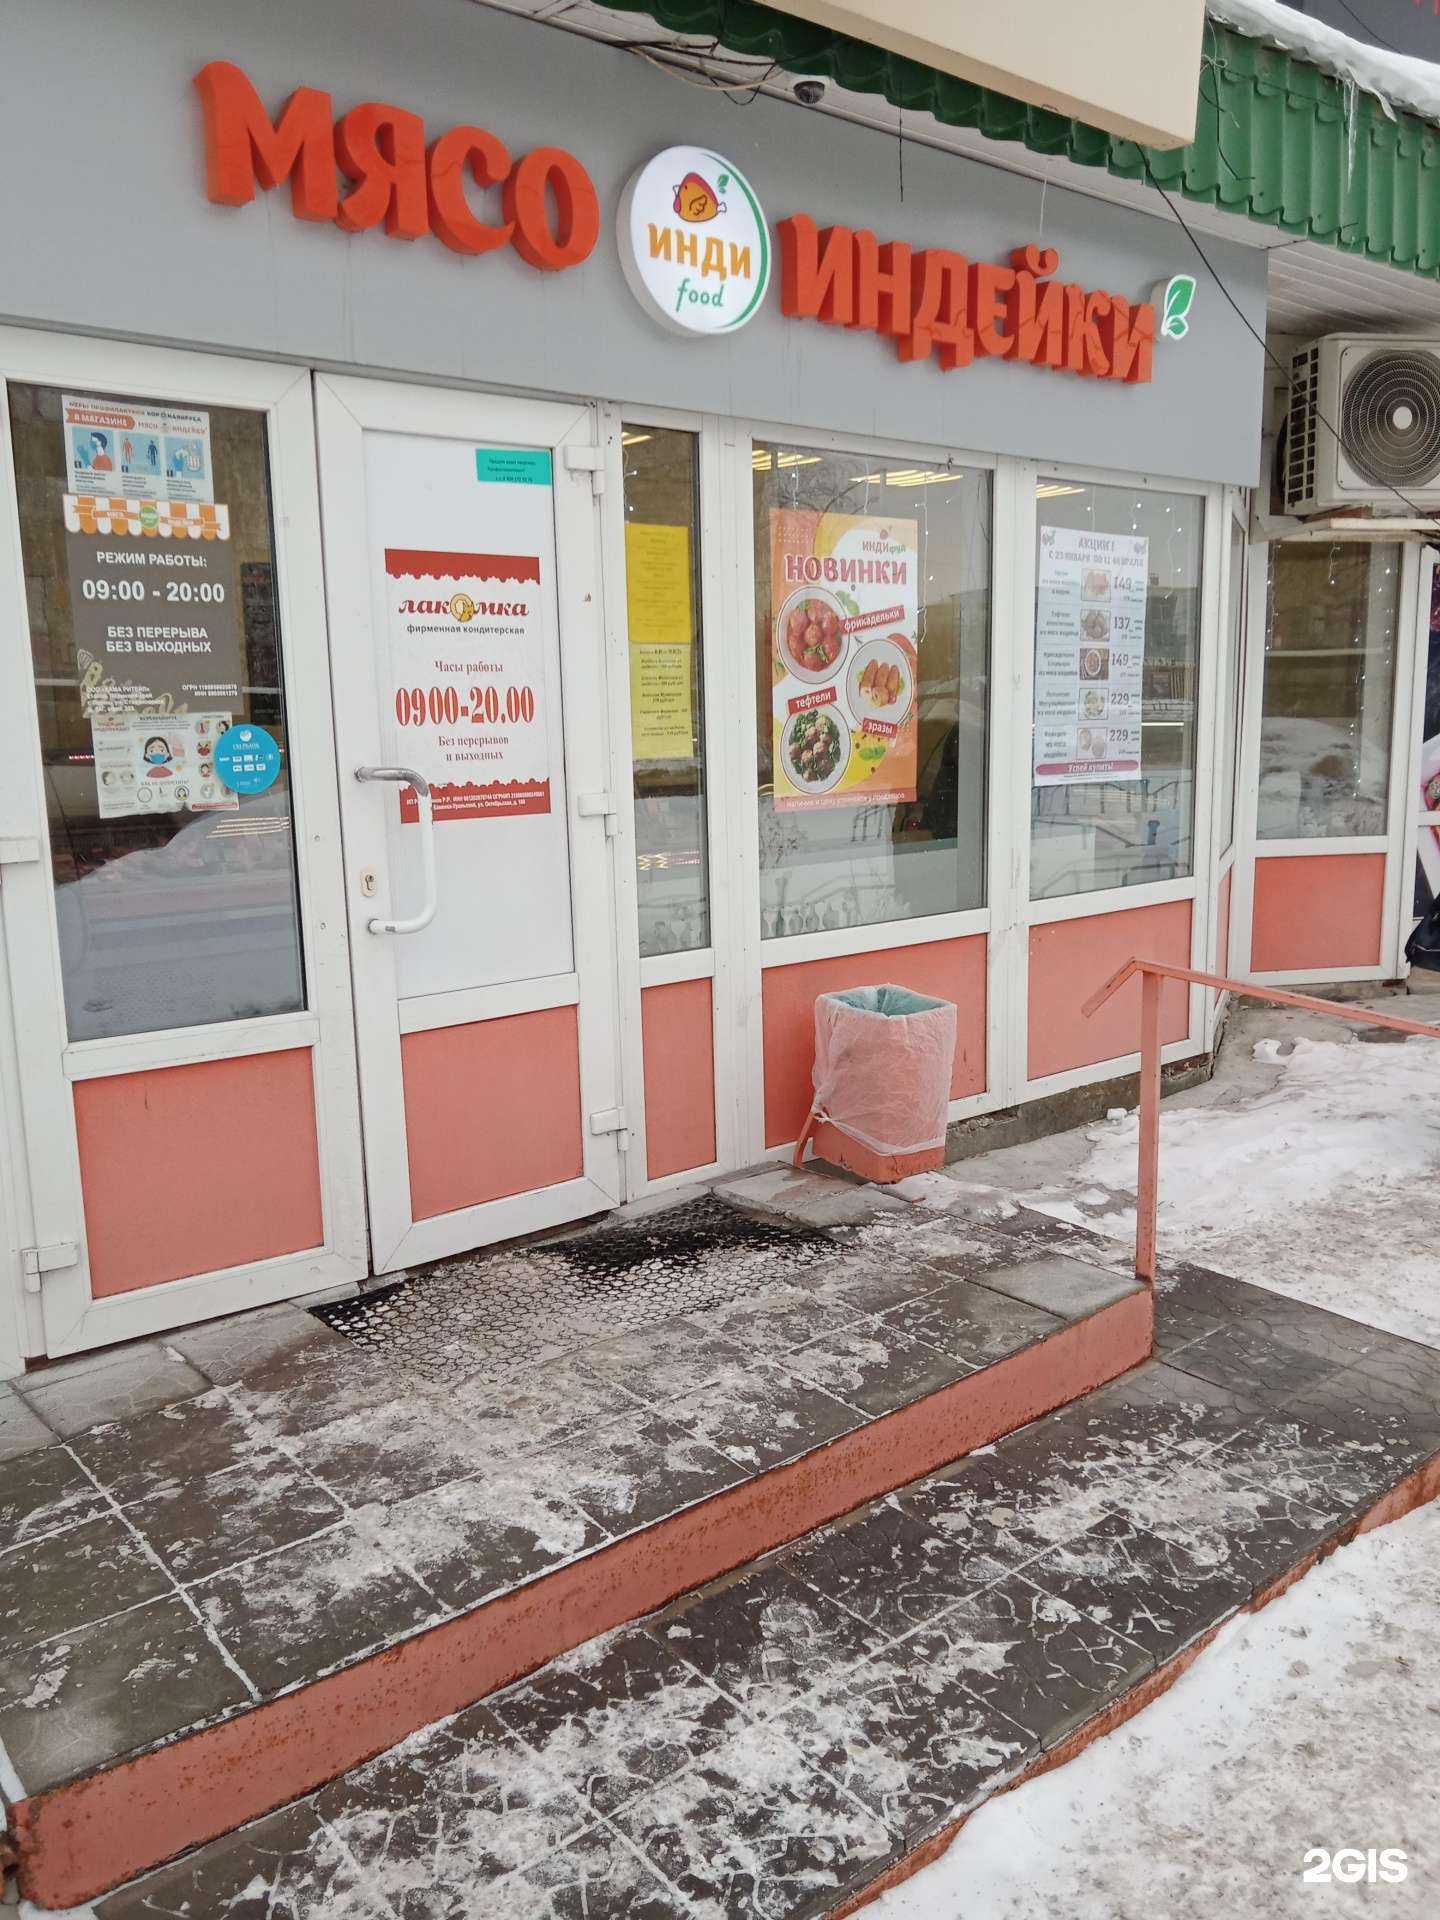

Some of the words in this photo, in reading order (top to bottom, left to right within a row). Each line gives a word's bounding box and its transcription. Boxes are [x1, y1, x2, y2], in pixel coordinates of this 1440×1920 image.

[193, 61, 600, 271] МЯСО
[648, 223, 751, 281] ИНДИ
[676, 278, 725, 312] food
[776, 213, 1155, 384] ИНДЕЙКИ
[96, 551, 146, 565] РЕЖИМ
[149, 553, 207, 568] РАБОТЫ:
[785, 554, 907, 585] НОВИНКИ
[82, 579, 145, 600] 09:00
[166, 582, 225, 602] 20:00
[844, 609, 900, 632] фрикадельки
[107, 626, 134, 639] БЕЗ
[137, 627, 208, 639] ПЕРЕРЫВА
[407, 623, 461, 636] фирменная
[463, 624, 525, 637] кондитерская
[106, 640, 132, 653] БЕЗ
[135, 641, 212, 655] ВЫХОДНЫХ
[434, 660, 463, 673] Часы
[466, 660, 504, 675] работы
[794, 692, 832, 709] тефтели
[1111, 693, 1130, 705] 229
[867, 720, 893, 734] зразы
[1109, 728, 1128, 741] 229
[438, 735, 456, 746] Без
[457, 735, 510, 748] перерывов
[445, 752, 451, 762] и
[455, 751, 504, 763] выходных
